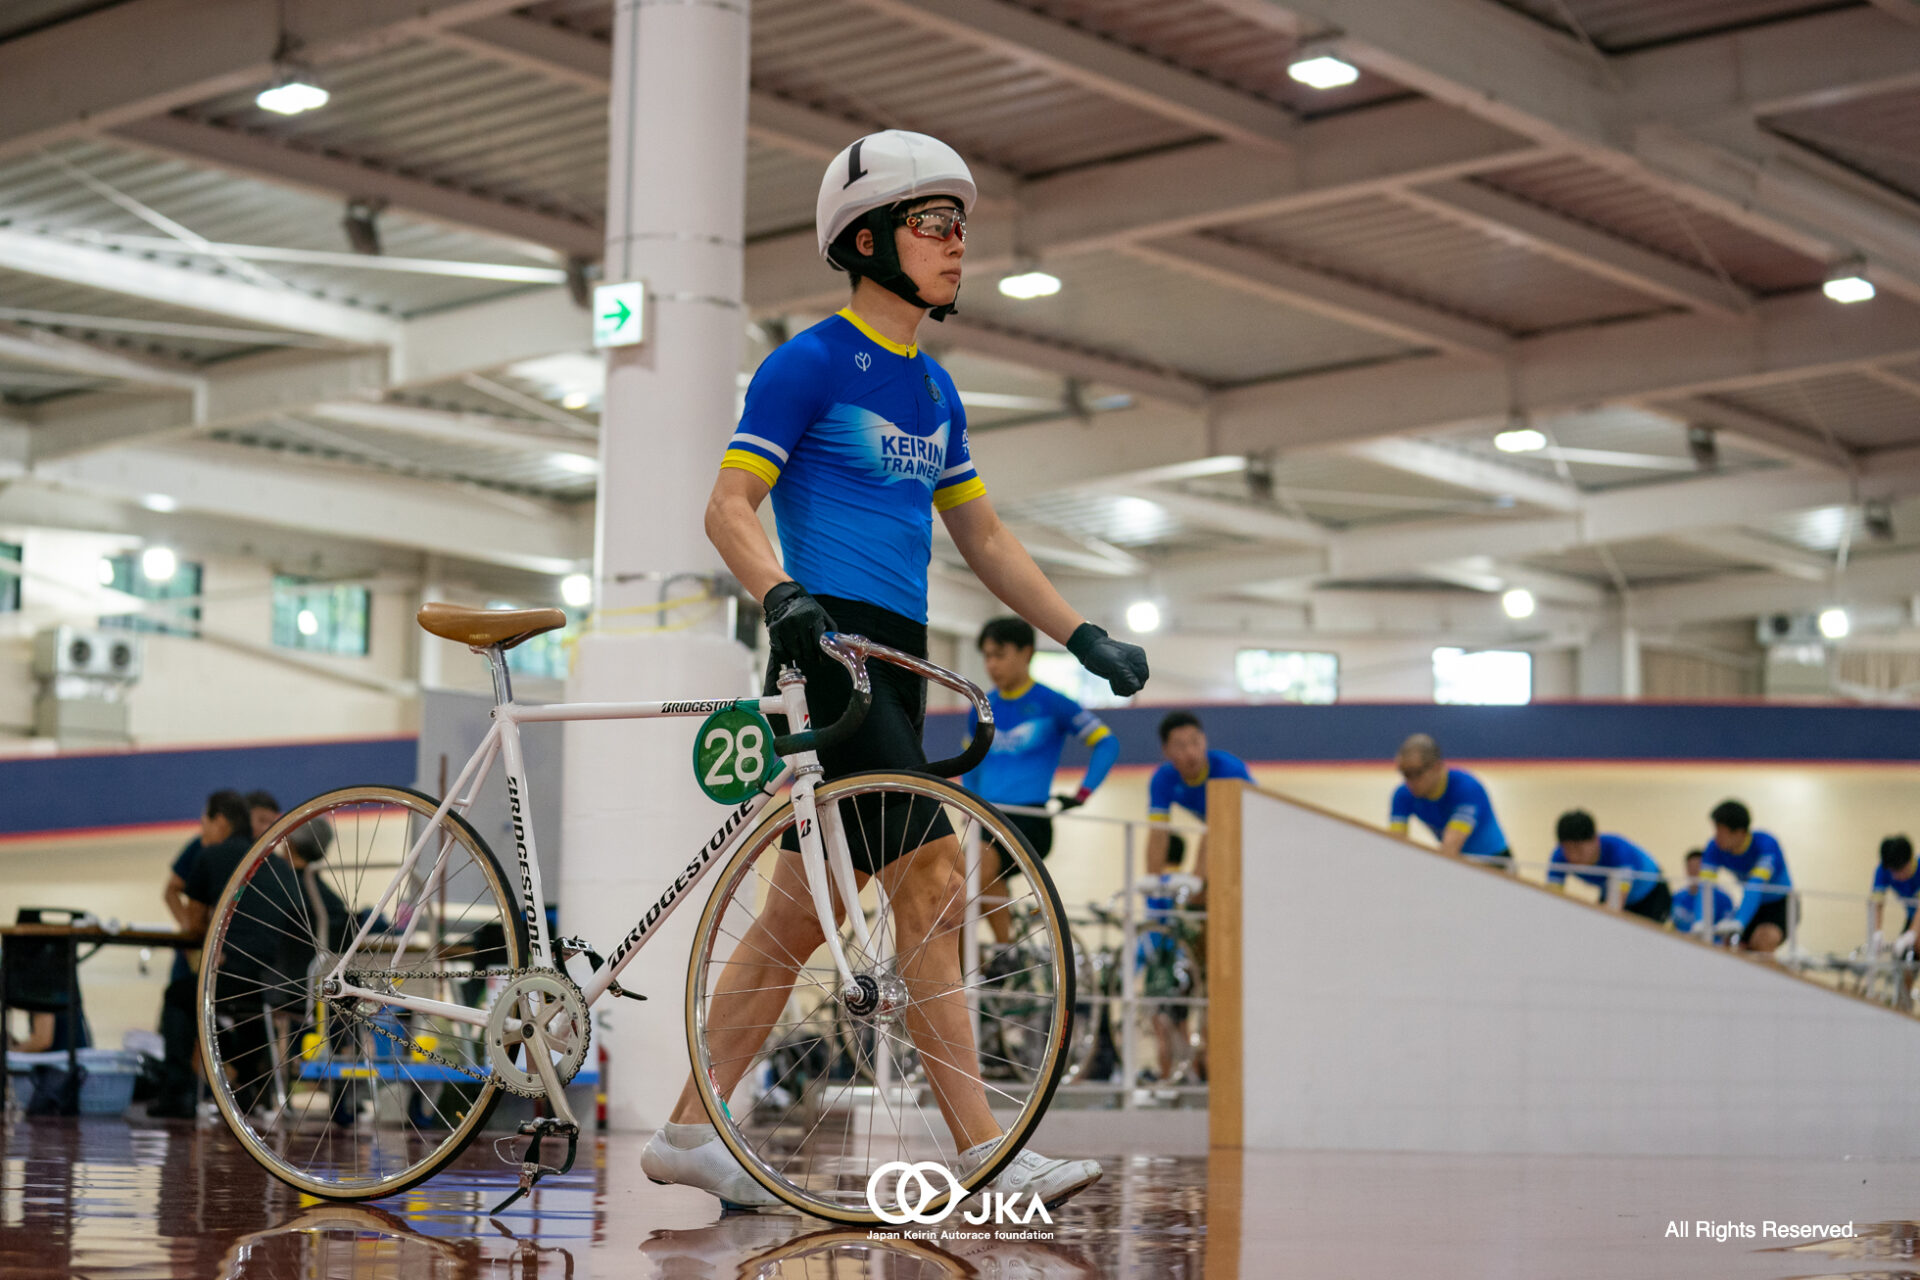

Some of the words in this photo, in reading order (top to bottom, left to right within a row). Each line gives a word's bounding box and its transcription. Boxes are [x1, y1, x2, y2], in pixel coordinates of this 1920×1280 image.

[881, 435, 943, 466] KEIRIN
[881, 457, 940, 481] TRAINEE
[704, 725, 764, 785] 28
[506, 775, 543, 958] BRIDGESTONE
[607, 799, 754, 972] BRIDGESTONE
